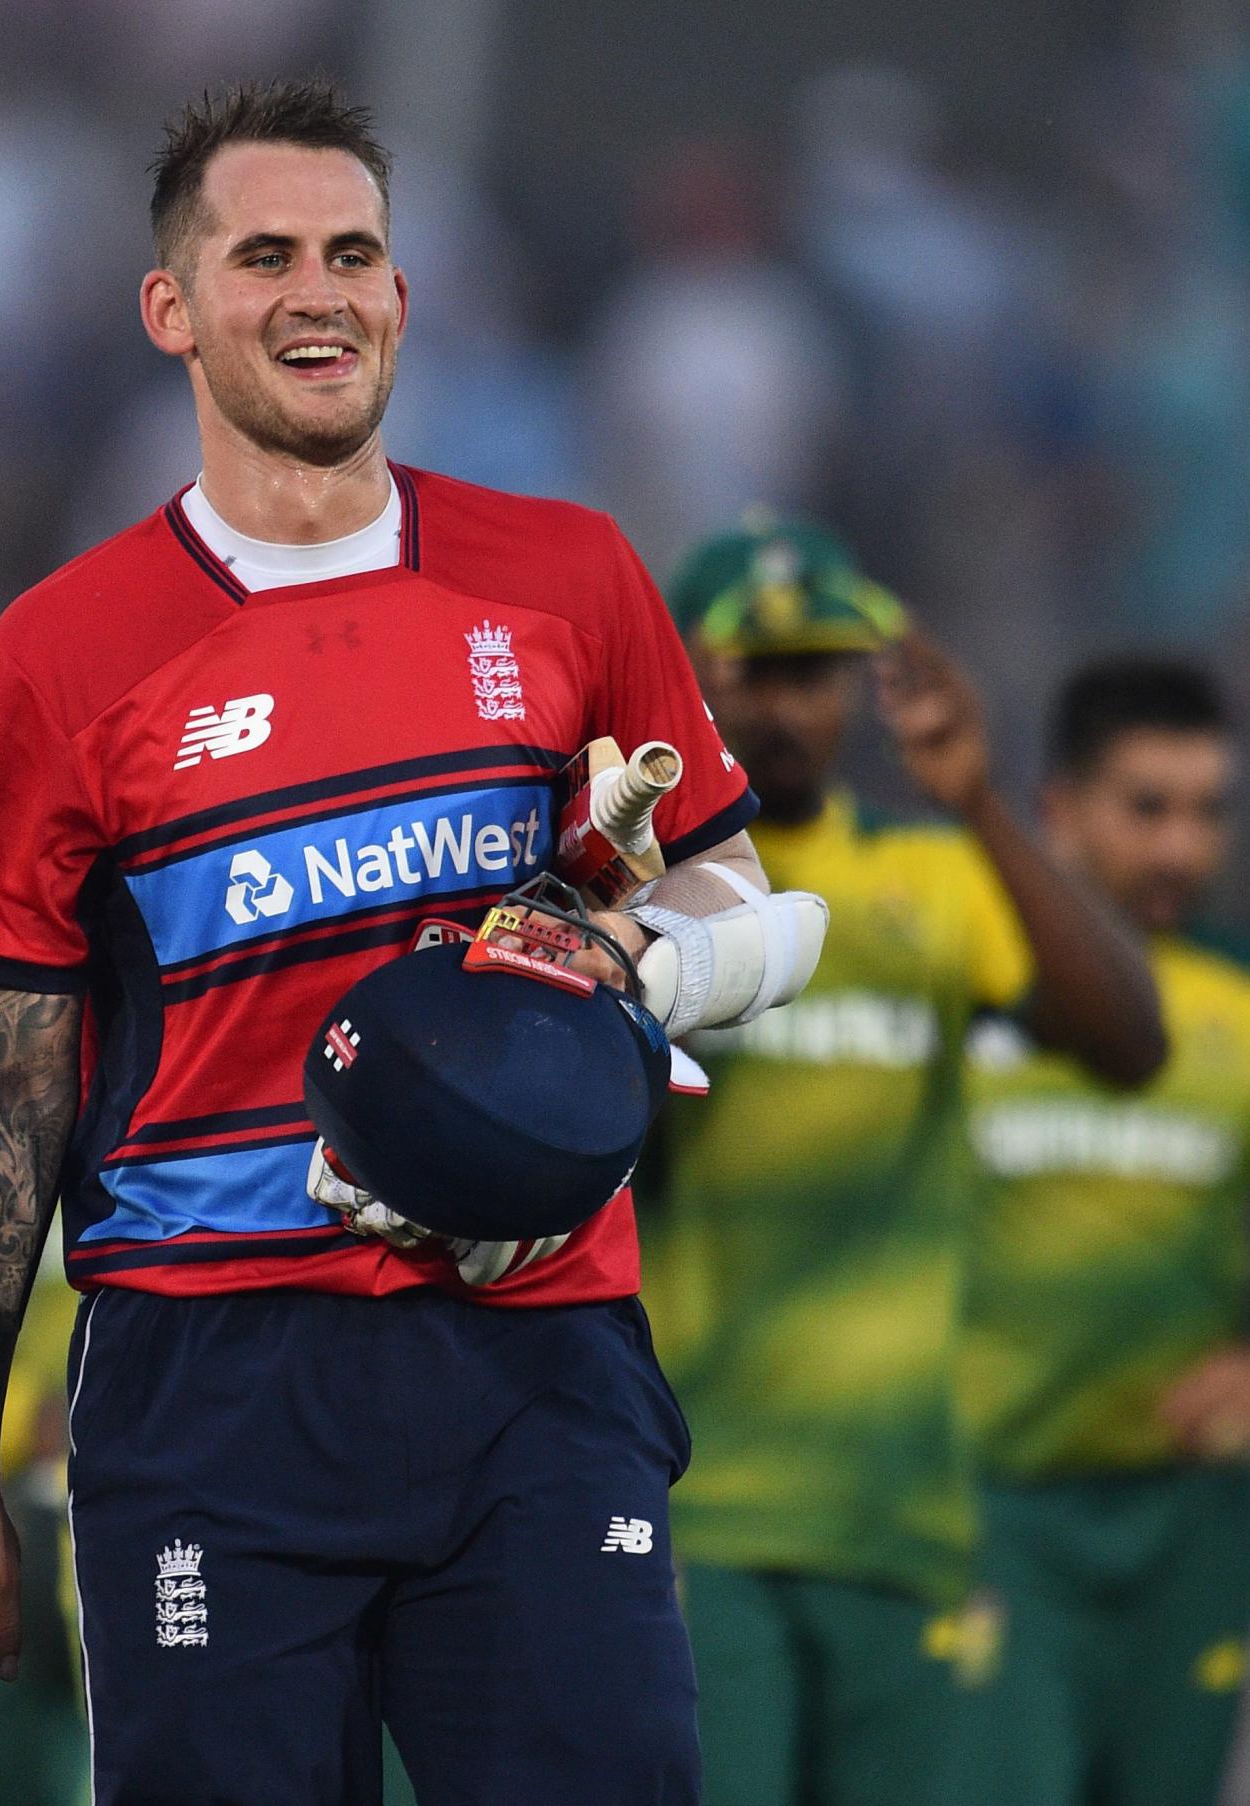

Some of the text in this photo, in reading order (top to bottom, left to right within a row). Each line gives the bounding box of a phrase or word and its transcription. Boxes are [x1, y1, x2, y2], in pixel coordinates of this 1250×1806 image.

[173, 693, 275, 771] NB
[303, 808, 540, 905] NatWest
[600, 1516, 653, 1554] NB
